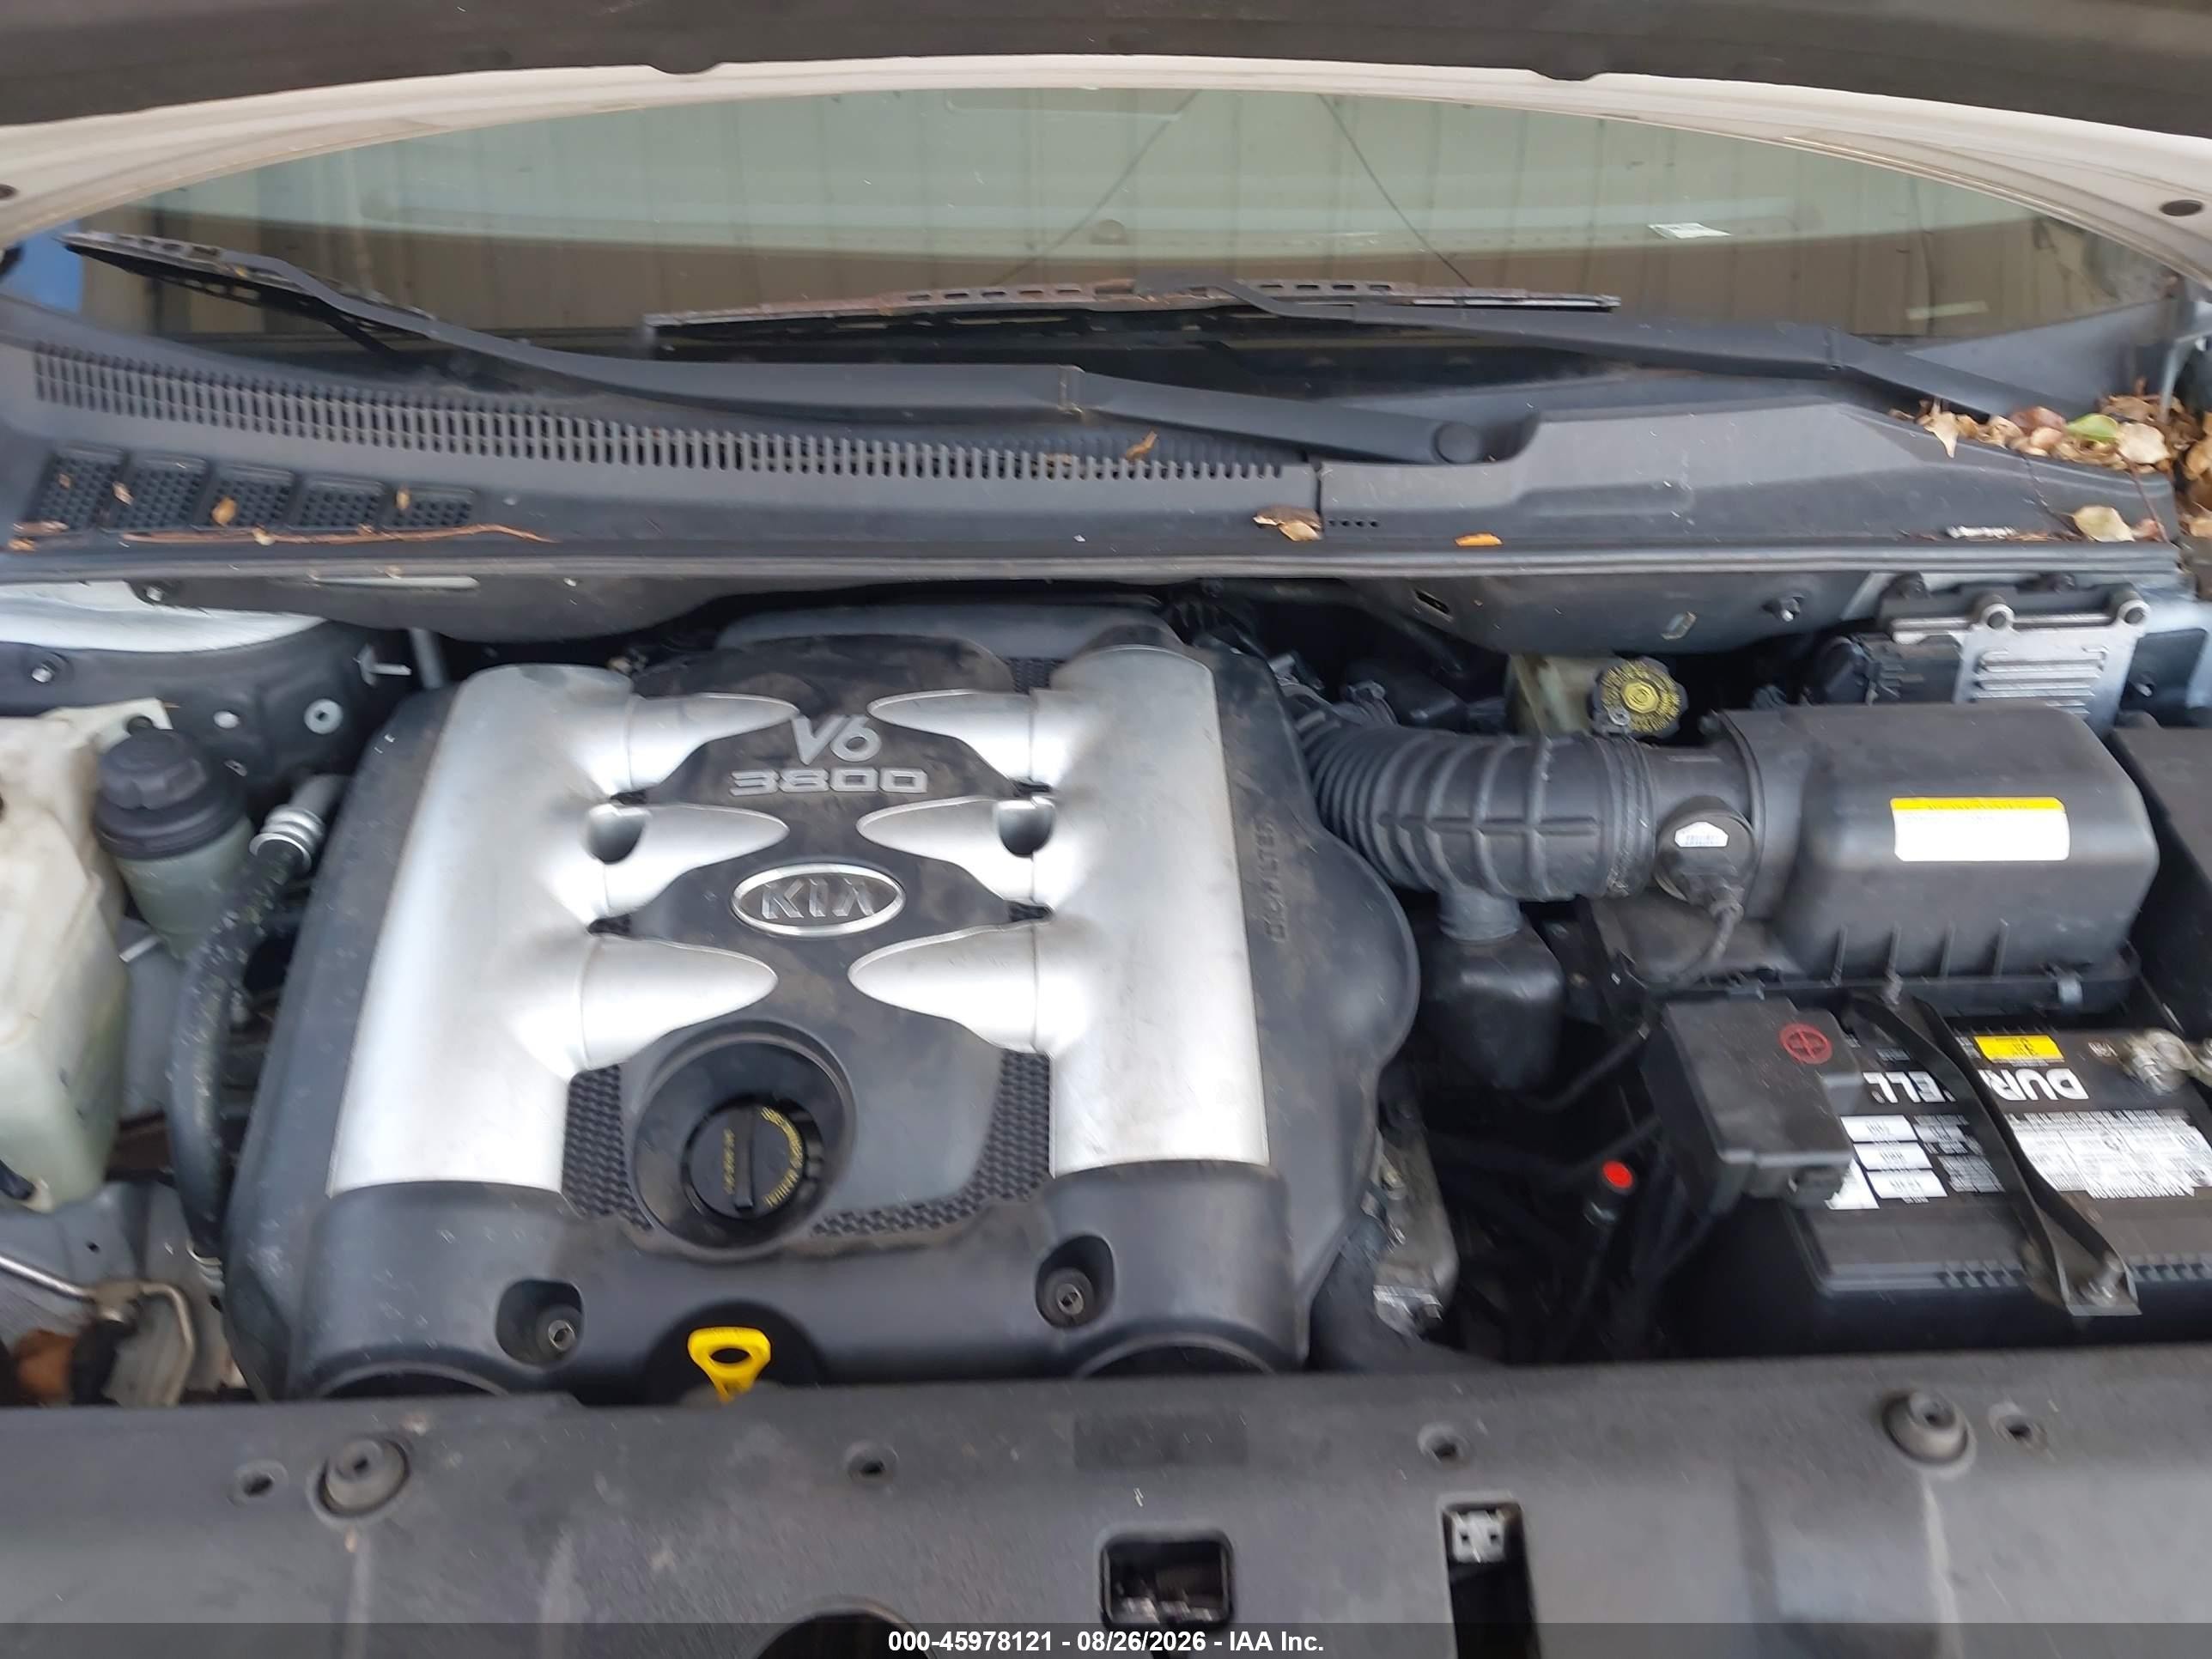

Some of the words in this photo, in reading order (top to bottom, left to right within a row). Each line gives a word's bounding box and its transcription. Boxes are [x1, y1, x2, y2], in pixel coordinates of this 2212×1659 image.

[790, 714, 882, 765] V6
[729, 768, 928, 796] 3800
[760, 877, 876, 921] KIA
